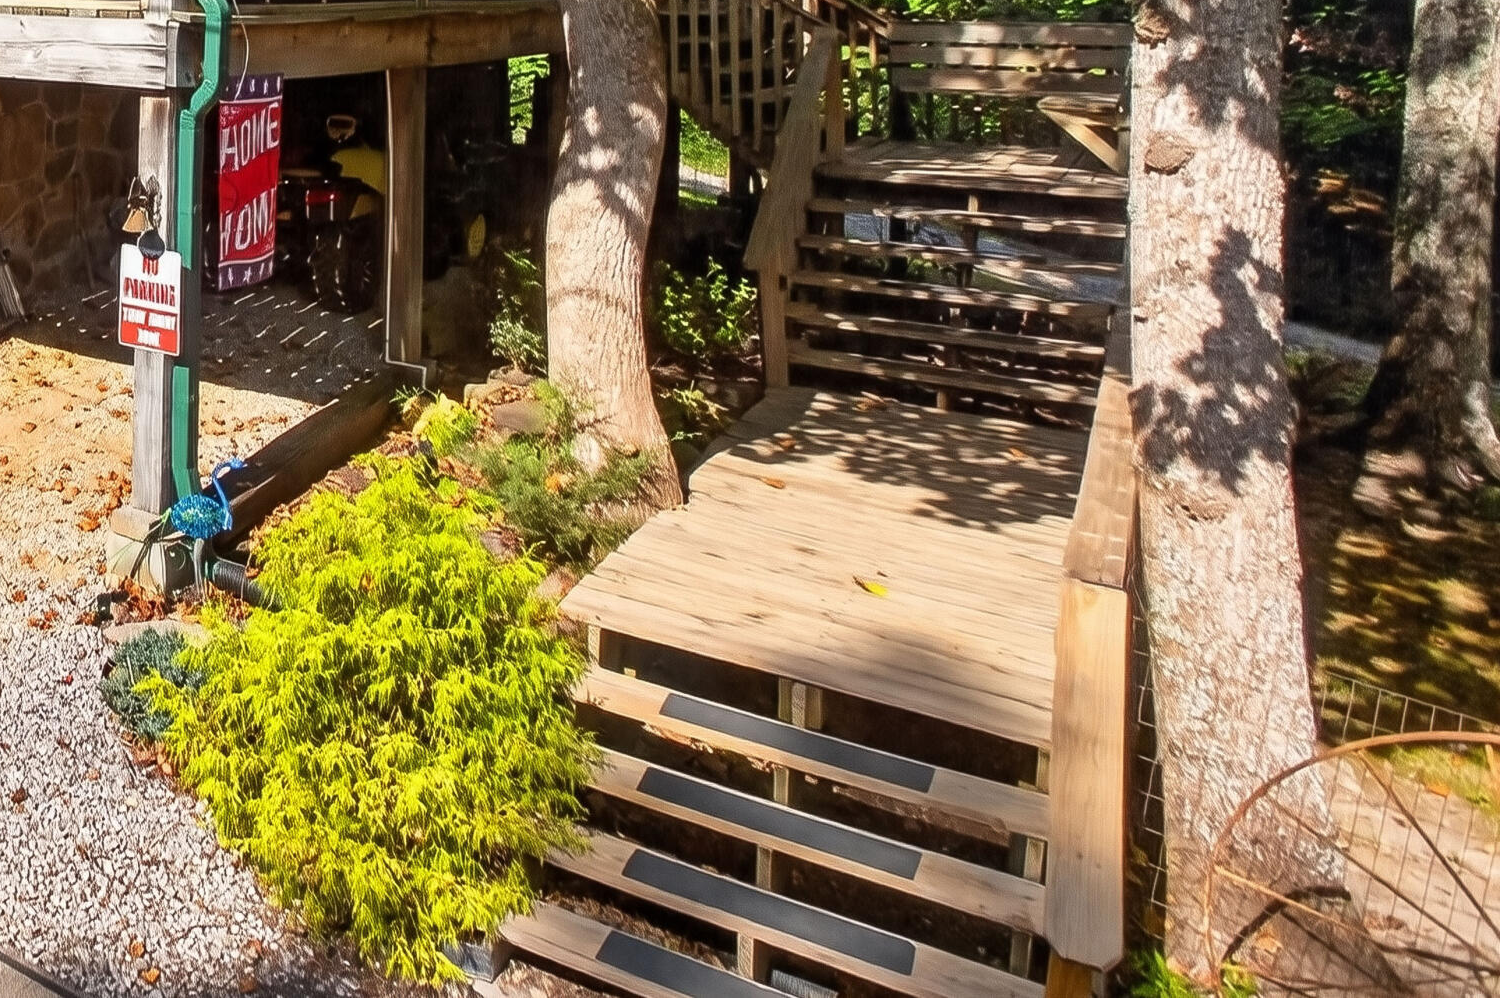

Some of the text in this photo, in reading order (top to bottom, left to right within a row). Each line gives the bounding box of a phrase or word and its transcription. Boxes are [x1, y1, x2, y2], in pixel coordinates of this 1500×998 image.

[220, 101, 280, 175] HOME
[142, 254, 159, 276] NO
[124, 277, 176, 307] PARKING
